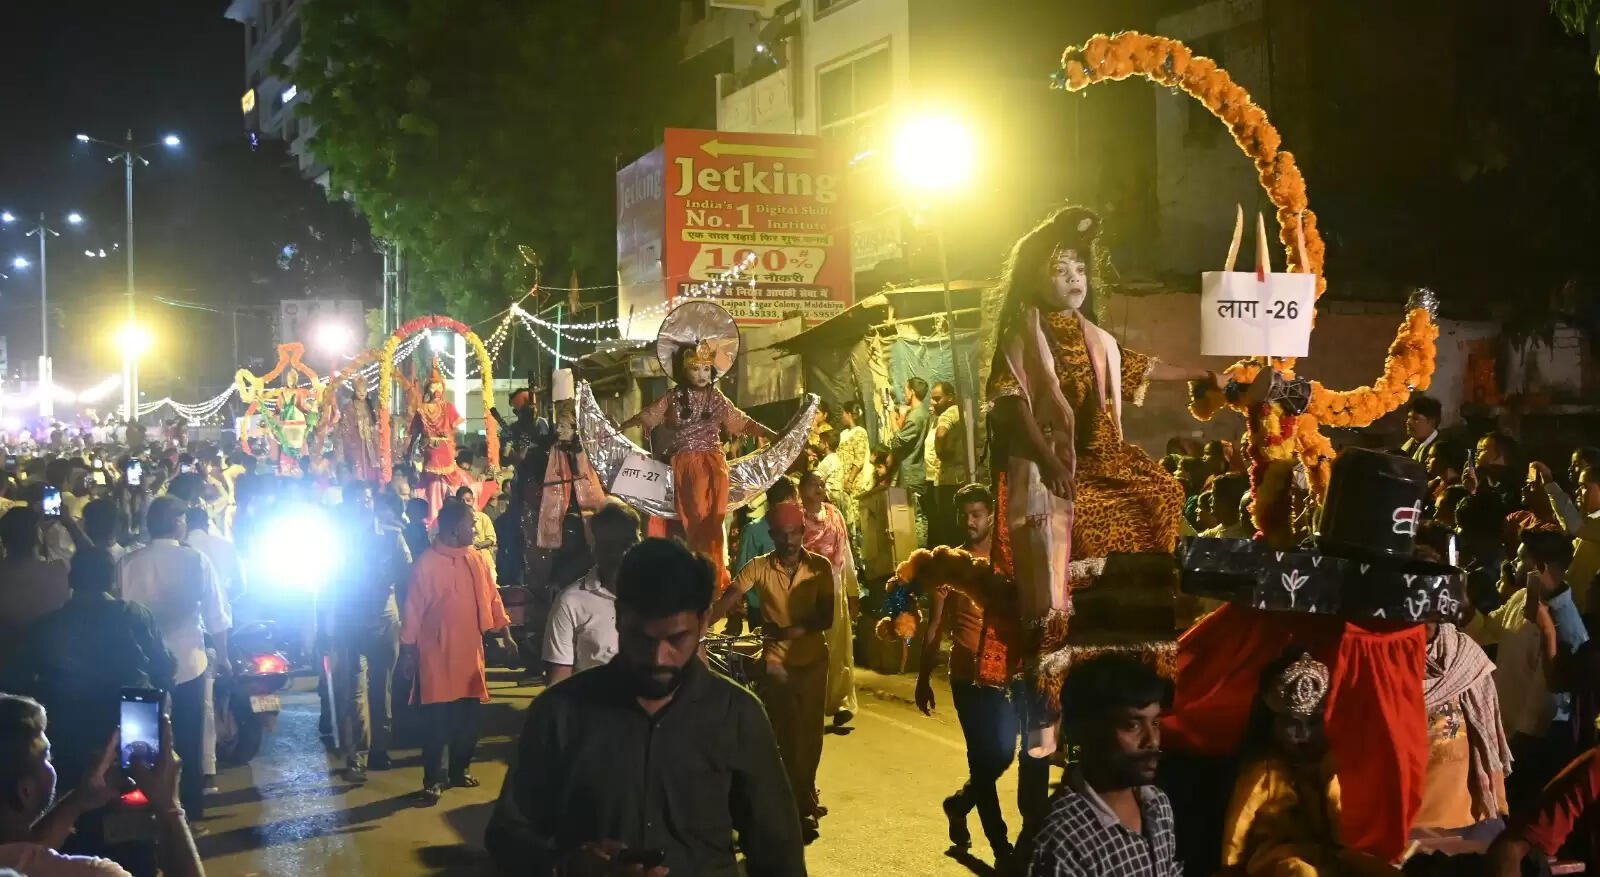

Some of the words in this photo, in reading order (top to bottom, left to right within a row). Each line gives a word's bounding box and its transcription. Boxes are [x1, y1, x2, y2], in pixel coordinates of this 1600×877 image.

[673, 156, 838, 203] Jetking
[685, 199, 733, 209] India's
[756, 204, 797, 216] Digital
[685, 209, 731, 228] No.
[736, 204, 754, 229] 1
[687, 231, 704, 240] एक
[707, 232, 730, 241] साल
[763, 273, 804, 282] नौकरी
[721, 300, 746, 309] Lajpat
[1217, 300, 1260, 319] लाग
[1265, 300, 1298, 319] -26
[622, 468, 640, 478] लाग
[642, 472, 660, 481] -27
